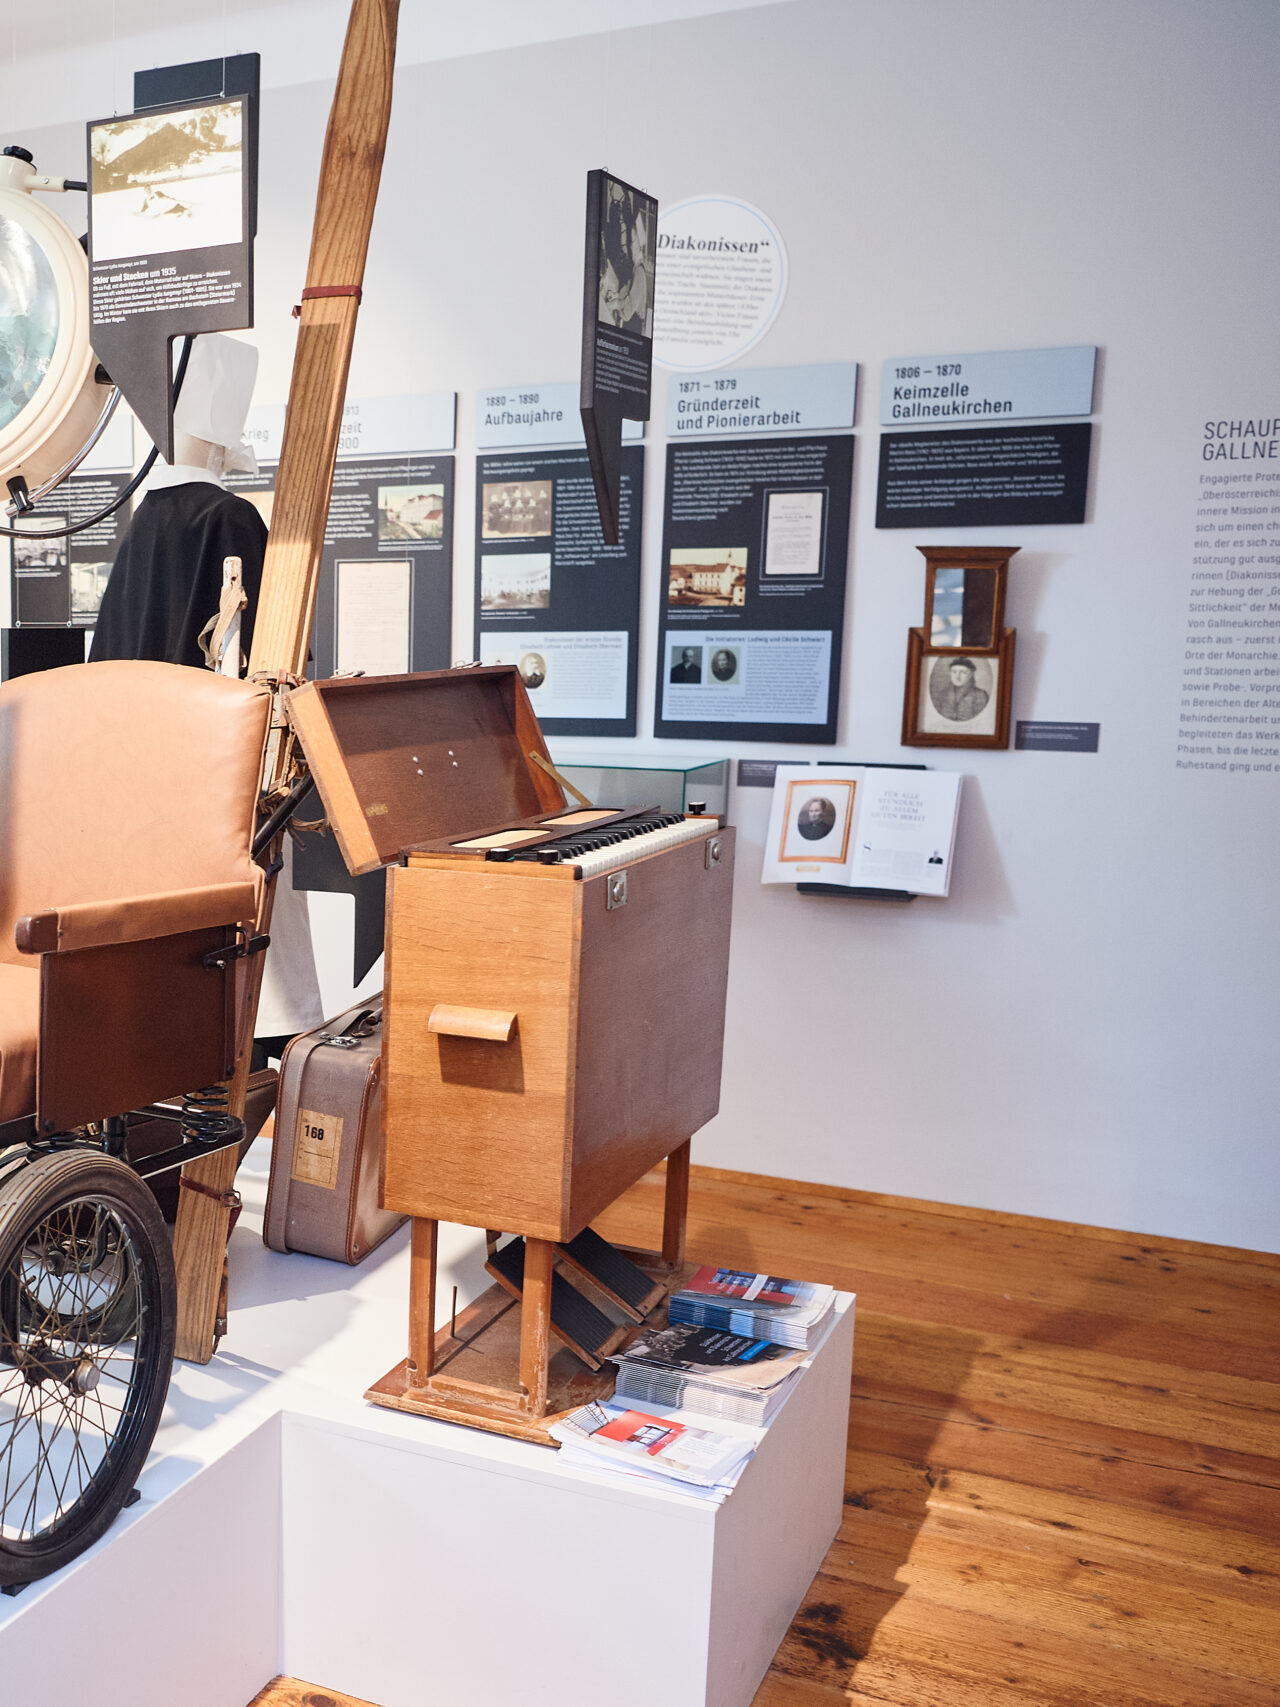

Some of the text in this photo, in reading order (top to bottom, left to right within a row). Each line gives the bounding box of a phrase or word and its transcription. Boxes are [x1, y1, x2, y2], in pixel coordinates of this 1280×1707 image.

[895, 366, 920, 379] 1806
[936, 363, 962, 376] 1870
[679, 381, 700, 393] 1871
[714, 379, 737, 391] 1879
[893, 382, 969, 401] Keimzelle
[678, 396, 760, 414] Gründerzeit
[892, 398, 1013, 419] Gallneukirchen
[485, 409, 564, 426] Aufbaujahre
[677, 410, 801, 430] und Pionierarbeit
[1230, 506, 1268, 515] Mission
[304, 1124, 324, 1141] 168
